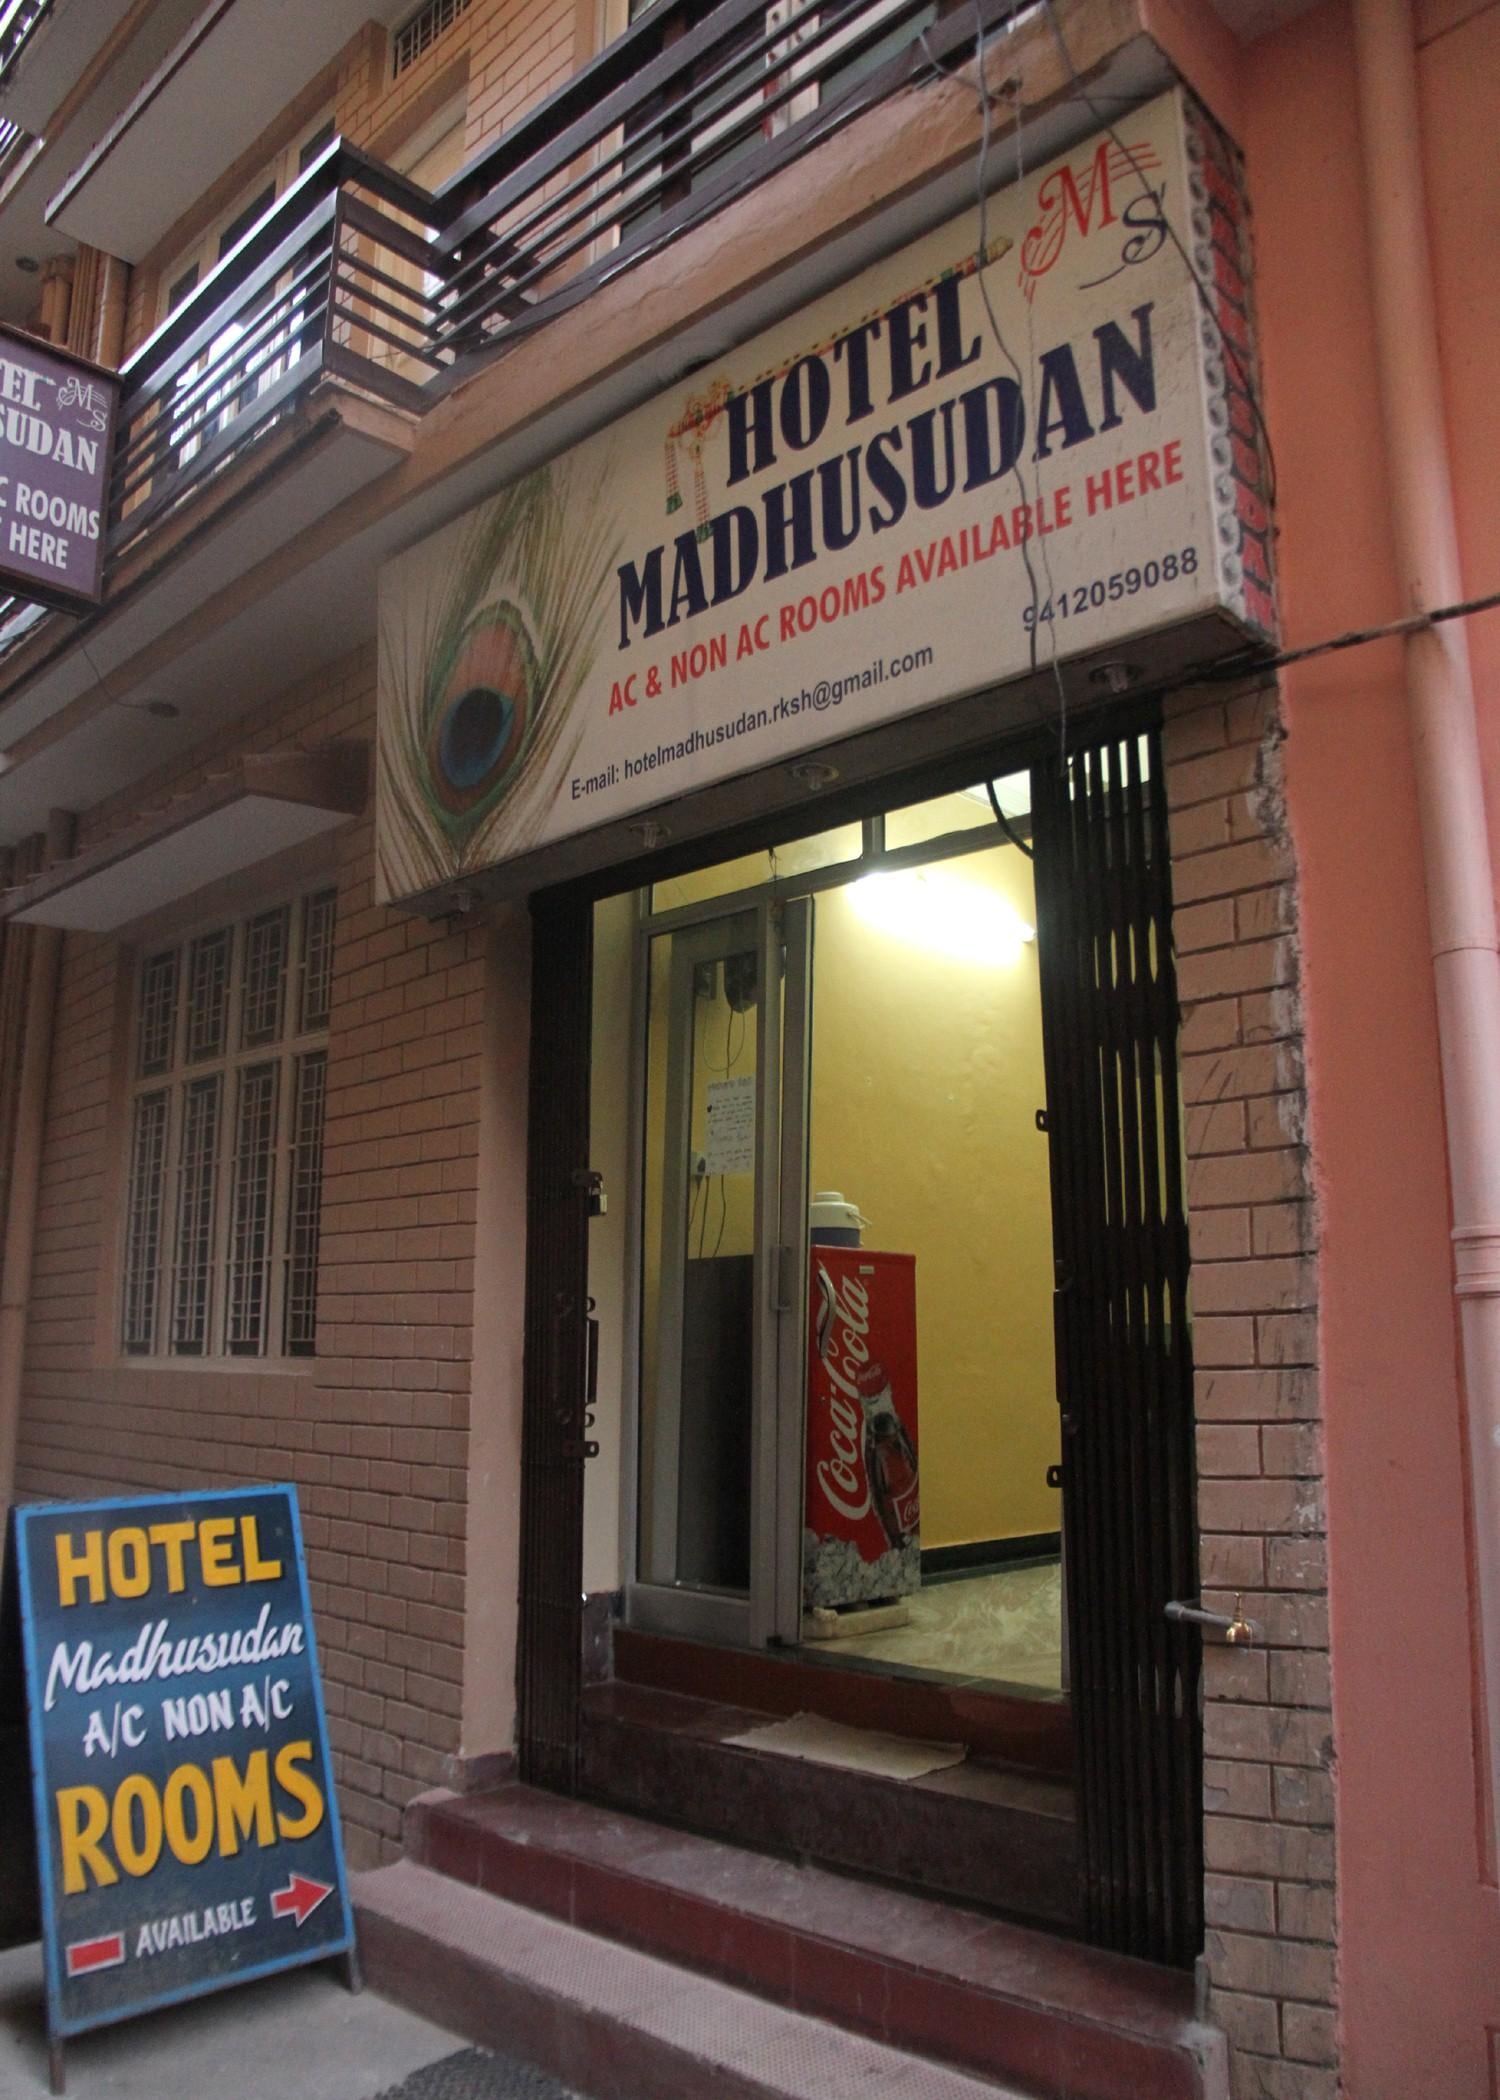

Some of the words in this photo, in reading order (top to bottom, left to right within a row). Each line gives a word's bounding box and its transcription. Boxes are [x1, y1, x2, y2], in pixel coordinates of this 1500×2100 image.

[723, 271, 982, 487] HOTEL
[15, 482, 100, 540] ROOMS
[616, 302, 1159, 650] MADHUSUDAN
[9, 521, 68, 570] HERE
[608, 673, 638, 717] AC
[645, 665, 662, 698] &
[671, 633, 727, 688] NON
[736, 614, 770, 661] AC
[779, 565, 886, 642] ROOMS
[896, 485, 1073, 594] AVAILABLE
[1085, 439, 1184, 518] HERE
[1022, 546, 1199, 632] 9412059088
[571, 765, 620, 801] E-mail:
[623, 646, 934, 780] hotelmadhusudan.rksh@gmail.com
[54, 1515, 282, 1607] HOTEL
[43, 1603, 305, 1711] Madhusudan
[82, 1702, 147, 1758] A/C
[161, 1685, 234, 1741] NON
[239, 1676, 294, 1734] A/C
[55, 1740, 325, 1895] ROOMS
[135, 1898, 257, 1957] AVAILABLE
